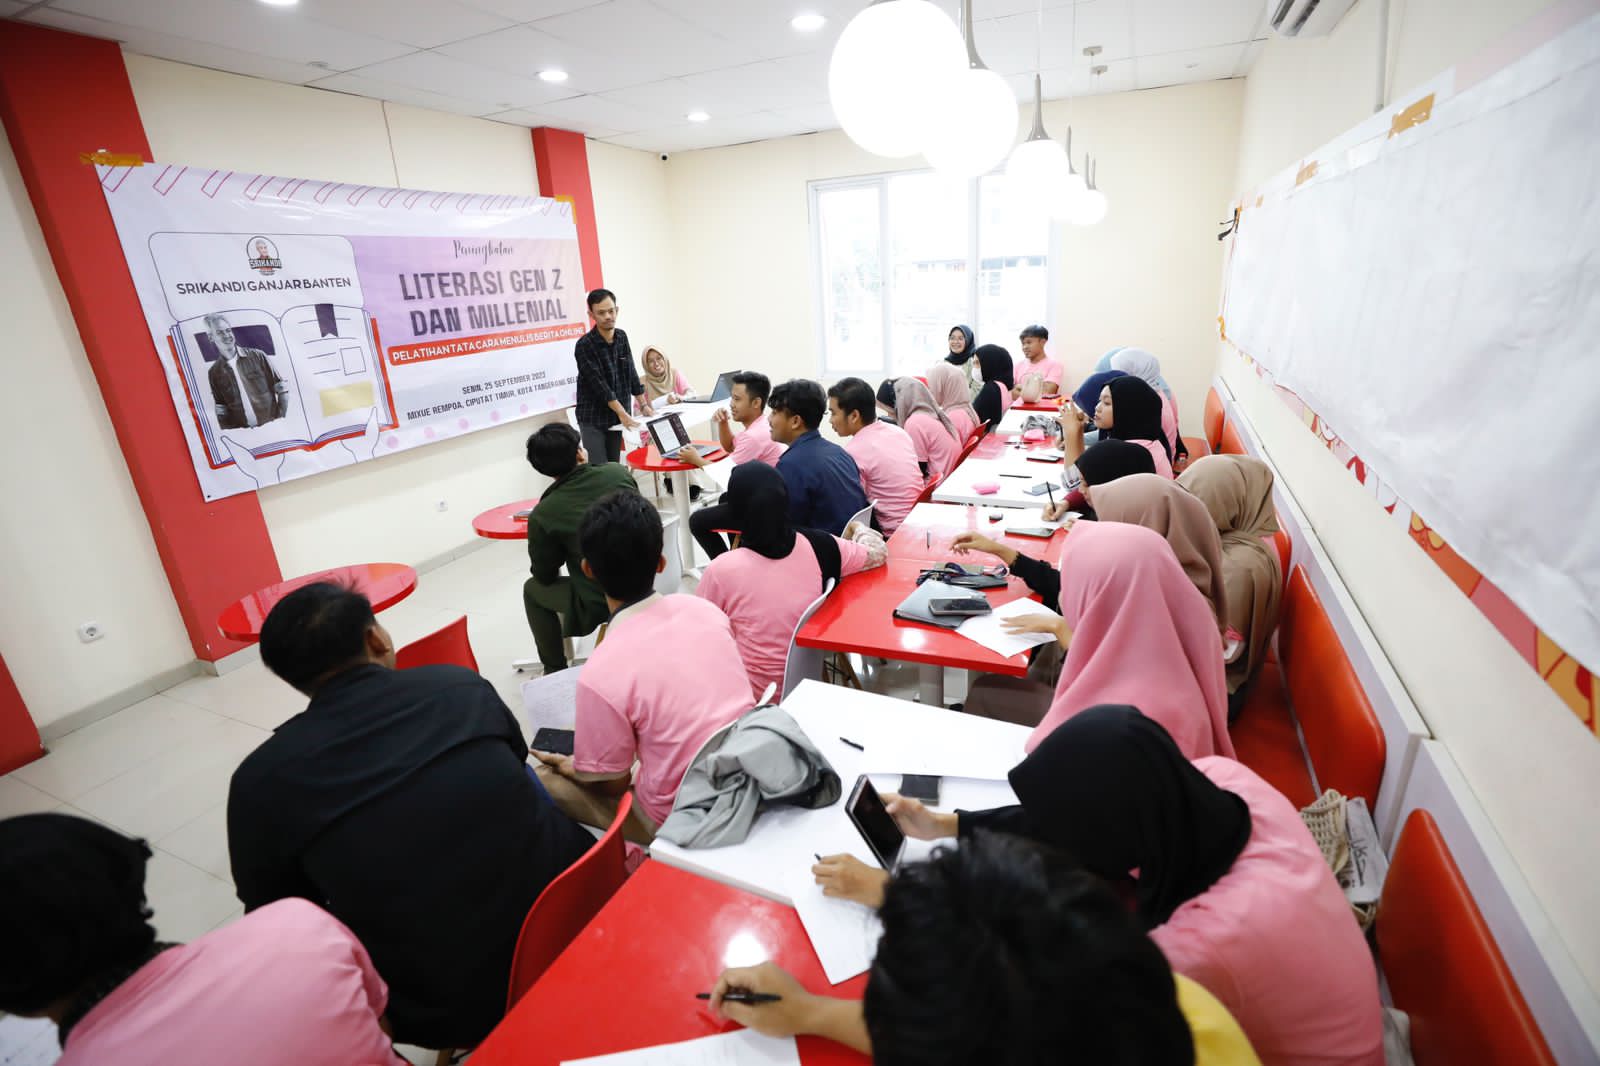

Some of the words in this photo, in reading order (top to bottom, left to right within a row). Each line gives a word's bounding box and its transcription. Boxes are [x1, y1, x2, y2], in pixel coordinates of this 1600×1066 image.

[176, 281, 245, 295] SRIKANDI
[247, 279, 301, 292] GANJAR
[303, 277, 351, 289] BANTEN
[399, 270, 504, 300] LITERASI
[509, 269, 547, 293] GEN
[552, 268, 563, 290] Z
[410, 307, 462, 336] DAN
[468, 298, 567, 329] MILLENIAL
[392, 345, 450, 361] PELATIHAN
[450, 342, 475, 353] TATA
[475, 337, 500, 350] CARA
[500, 334, 534, 345] MENULIS
[534, 330, 560, 342] BERITA
[560, 327, 585, 337] ONLINE
[462, 384, 483, 395] SENIN,
[485, 382, 493, 391] 25
[494, 374, 530, 388] SEPTEMBER
[407, 408, 431, 420] MIXUE
[432, 401, 464, 414] REMPOA,
[466, 394, 494, 407] CIPUTAT
[517, 385, 533, 396] KOTA
